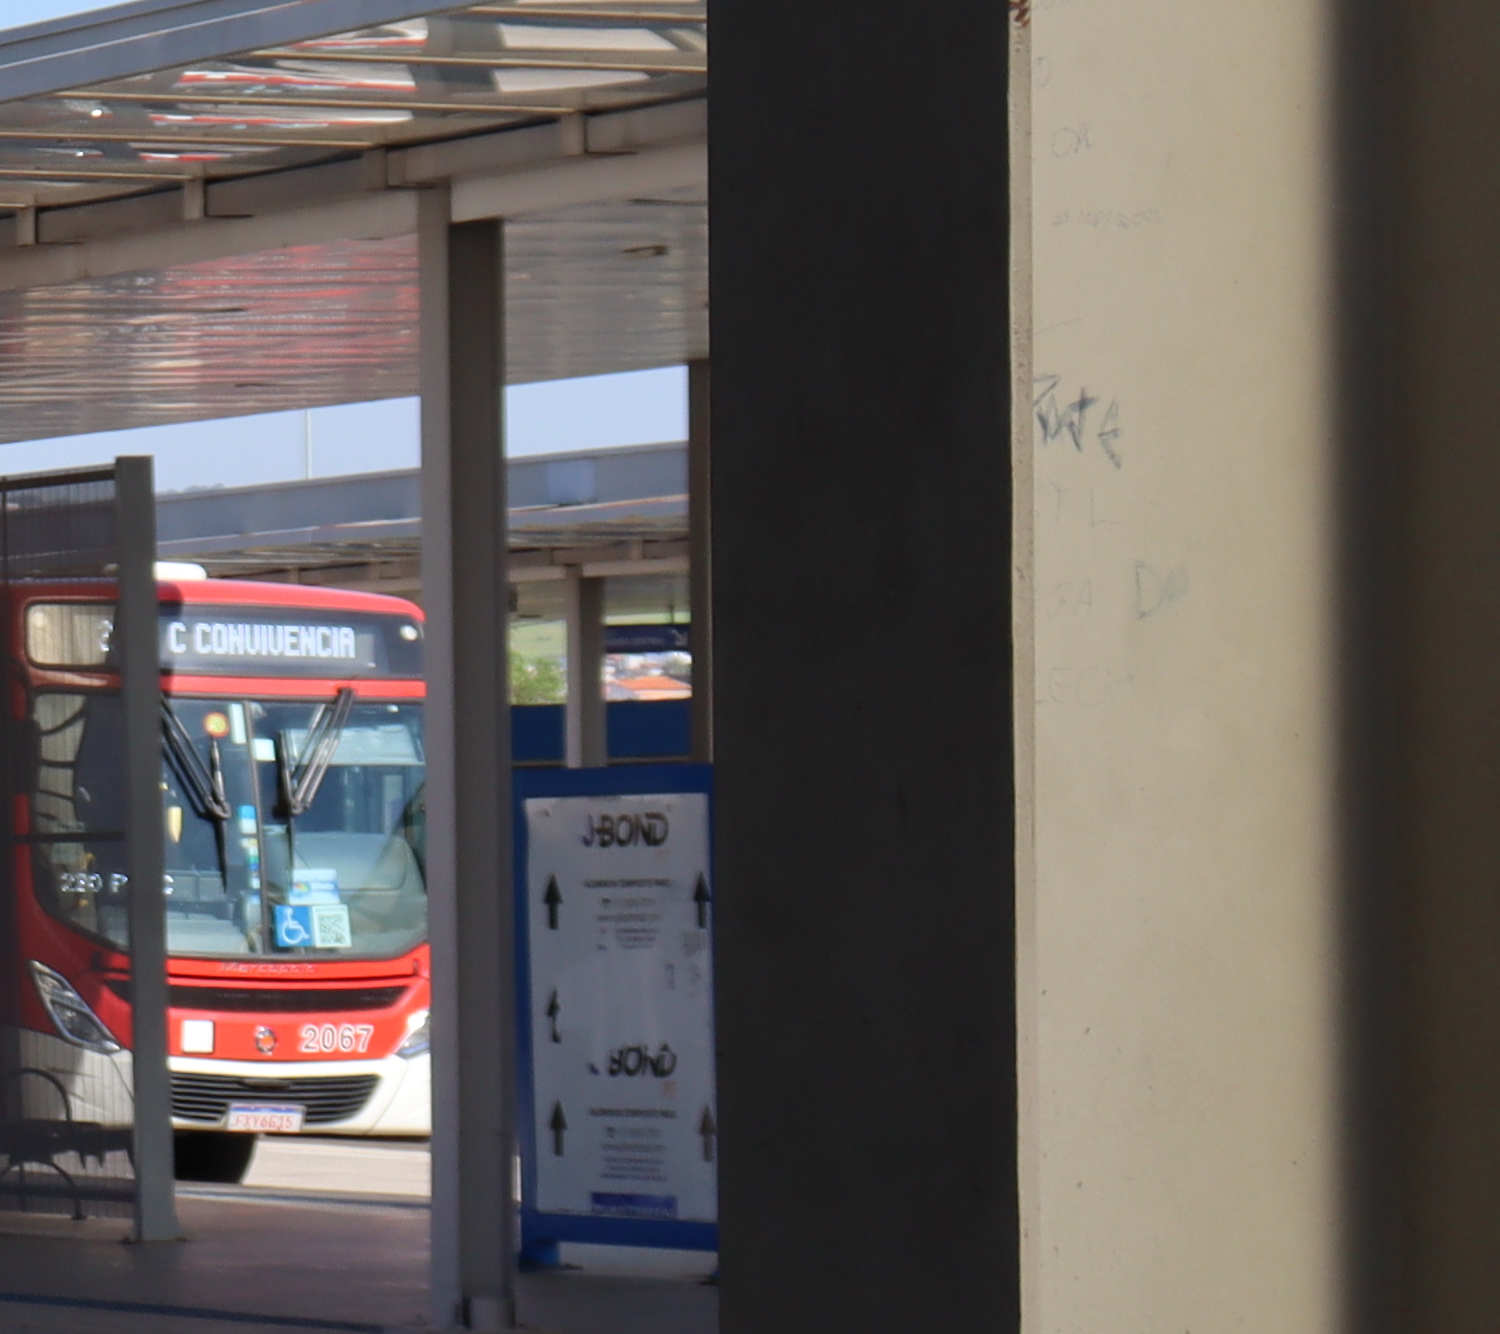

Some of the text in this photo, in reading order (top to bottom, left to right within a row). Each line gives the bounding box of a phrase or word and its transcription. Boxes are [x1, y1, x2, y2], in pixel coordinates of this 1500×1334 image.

[168, 621, 356, 658] C CONVIVENCIA
[300, 1023, 375, 1053] 2067
